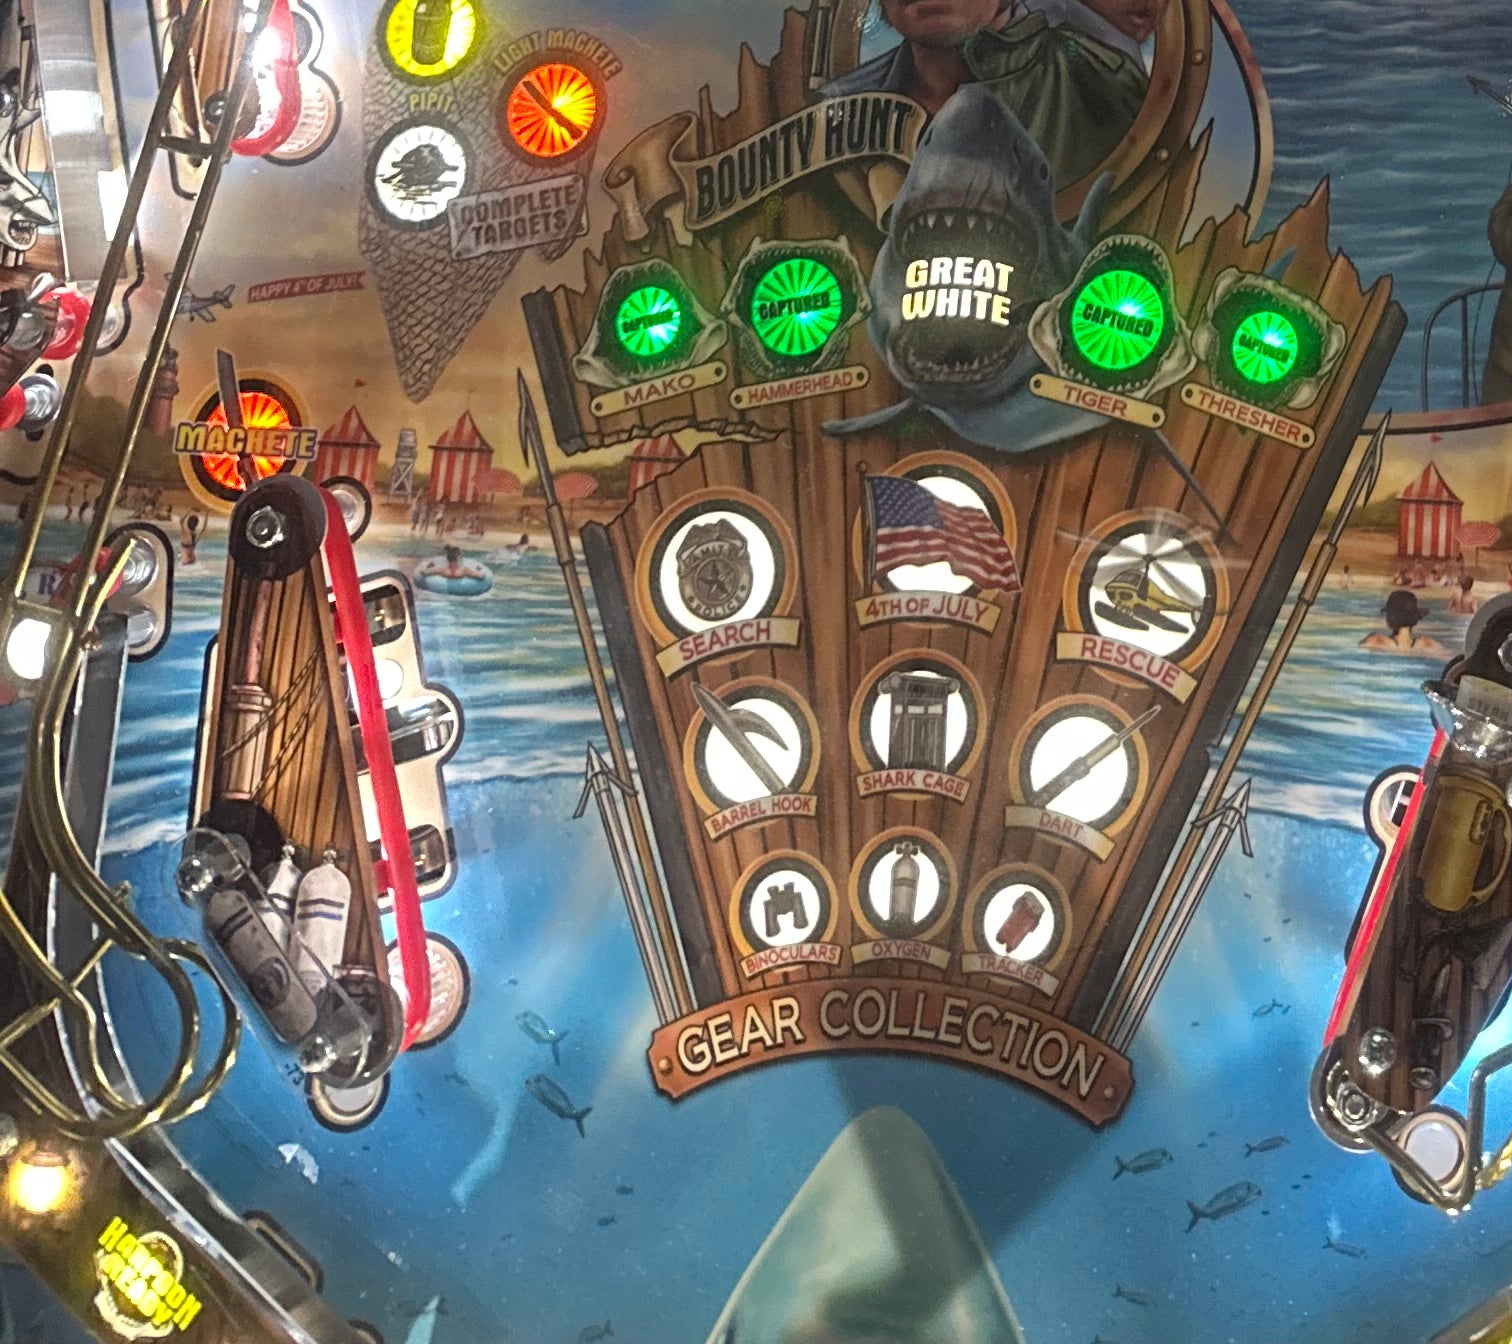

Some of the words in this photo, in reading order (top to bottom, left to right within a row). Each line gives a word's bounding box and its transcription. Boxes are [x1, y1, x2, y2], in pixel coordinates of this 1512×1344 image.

[497, 31, 542, 76] LIGHT
[546, 28, 624, 81] MACHETE
[409, 92, 456, 112] PIPIT
[695, 114, 817, 222] BOUNTY
[824, 101, 914, 162] HUNT
[460, 184, 577, 224] COMPLETE
[471, 211, 567, 248] TARGETS
[251, 283, 290, 301] HAPPY
[307, 279, 323, 292] OF
[325, 275, 360, 291] JULY!
[906, 257, 1015, 293] GREAT
[758, 291, 831, 320] CAPTURED
[901, 288, 1012, 326] WHITE
[1082, 301, 1155, 339] CAPTURED
[1238, 332, 1291, 363] CAPTURED
[623, 372, 697, 407] MAKO
[747, 371, 854, 405] HAMMERHEAD
[1064, 383, 1129, 418] TIGER
[1199, 389, 1301, 443] THRESHER
[174, 421, 318, 460] MACHETE
[865, 598, 901, 620] 4TH
[905, 596, 931, 613] OF
[932, 595, 989, 625] JULY
[679, 621, 772, 662] SEARCH
[1080, 634, 1182, 691] RESCUE
[862, 769, 917, 792] SHARK
[922, 771, 966, 798] CAGE
[710, 800, 767, 833] BARREL
[771, 794, 813, 814] HOOK
[1039, 811, 1085, 839] DART
[745, 945, 839, 974] BINOCULARS
[871, 942, 934, 962] OXYGEN
[978, 954, 1045, 987] TRACKER
[677, 995, 805, 1074] GEAR
[818, 988, 1106, 1099] COLLECTION
[99, 1216, 202, 1331] HARPOON
